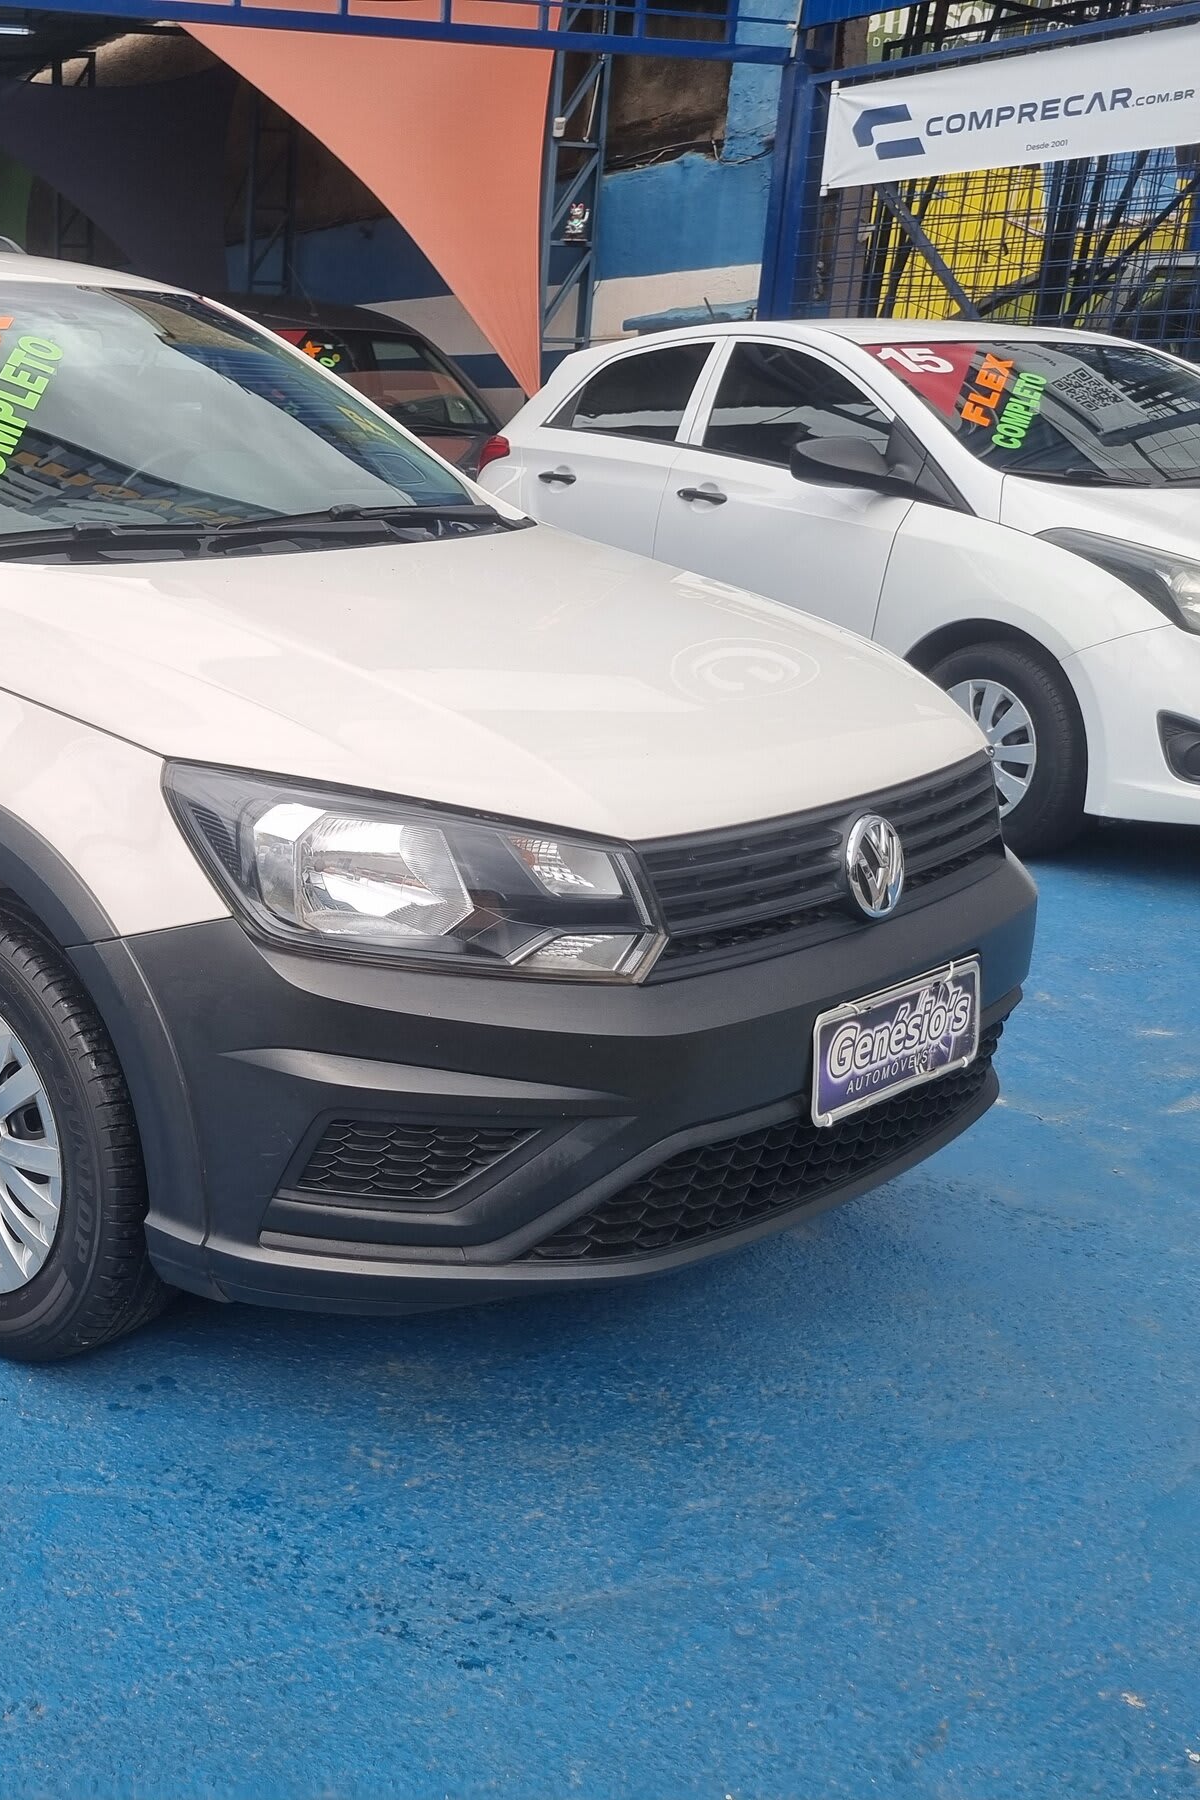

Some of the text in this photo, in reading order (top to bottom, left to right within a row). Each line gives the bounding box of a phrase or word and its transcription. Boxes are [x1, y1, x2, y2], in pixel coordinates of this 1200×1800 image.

[1025, 138, 1069, 152] Desde 2001
[876, 347, 954, 373] 15
[960, 353, 1015, 427] FLEX
[991, 372, 1048, 449] COMPLETO
[829, 989, 970, 1078] Genésio's
